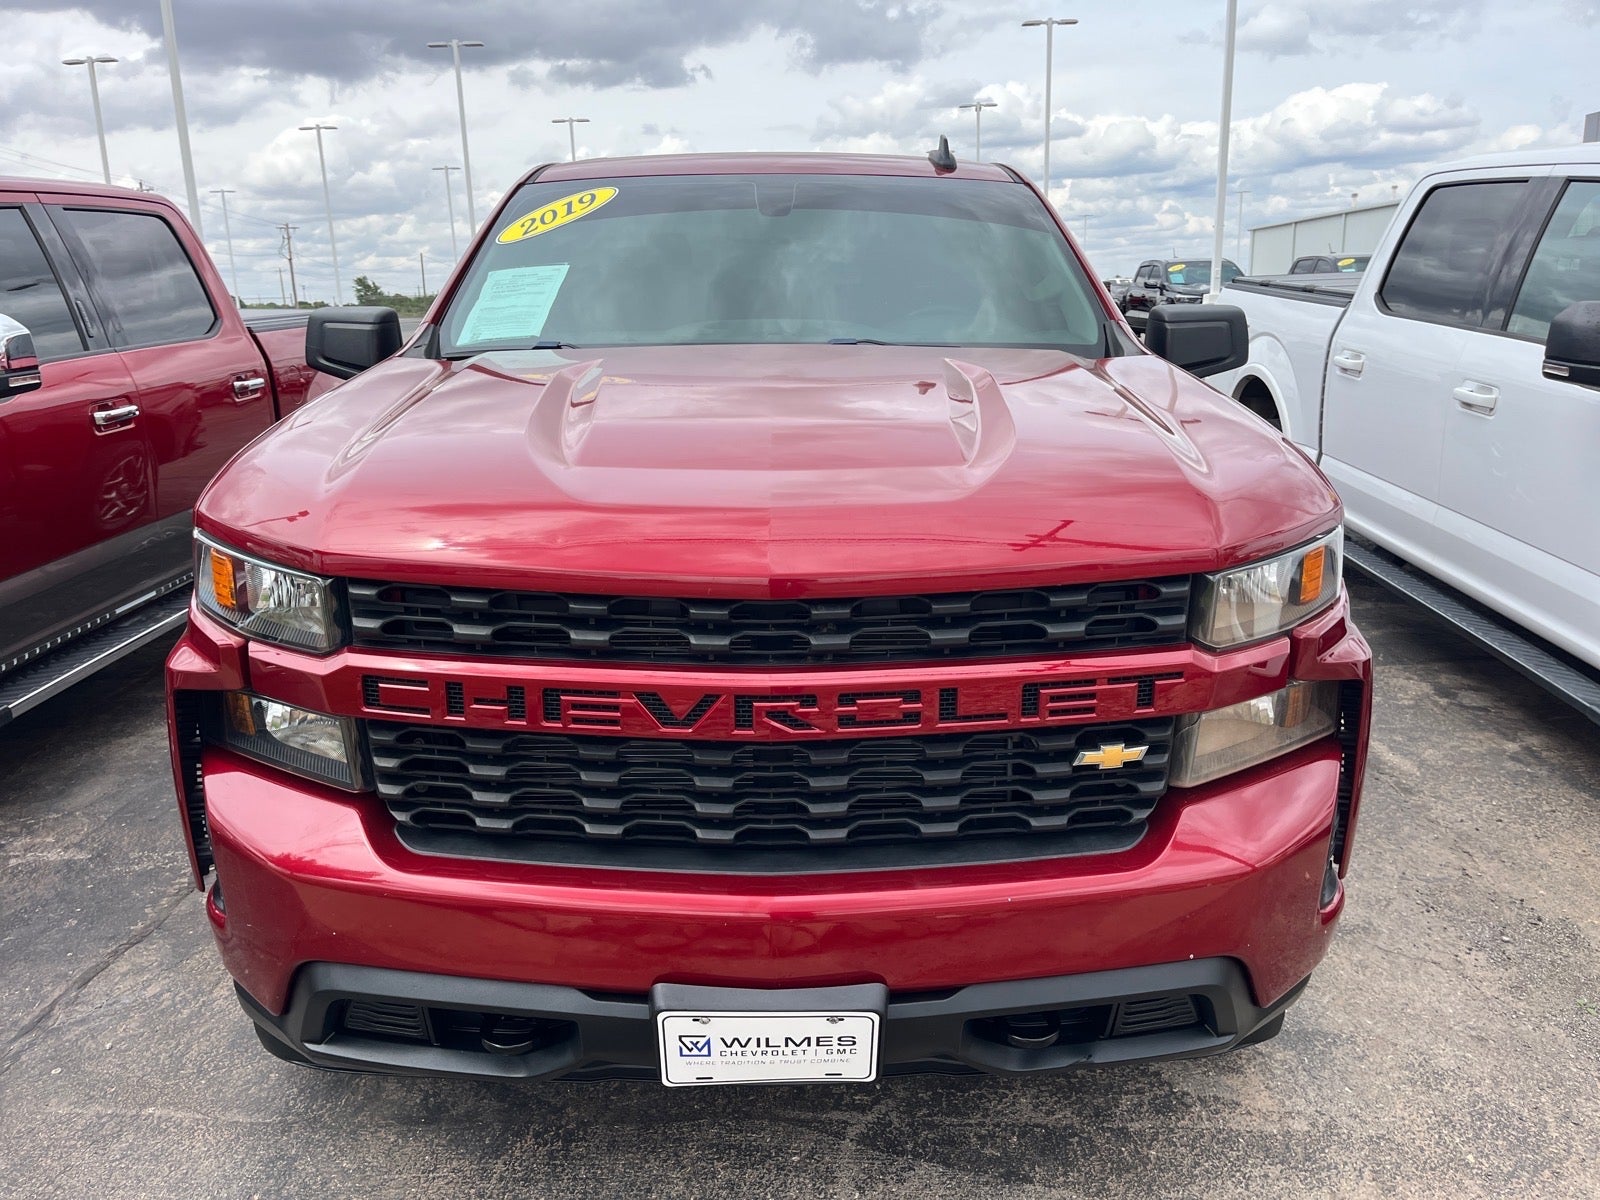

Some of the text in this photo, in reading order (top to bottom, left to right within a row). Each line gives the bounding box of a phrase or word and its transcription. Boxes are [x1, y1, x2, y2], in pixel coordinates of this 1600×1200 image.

[519, 192, 597, 236] 2019
[361, 671, 1185, 735] CHEVROLET
[719, 1035, 857, 1049] WILMES
[719, 1047, 857, 1058] CHEVROLET GMC
